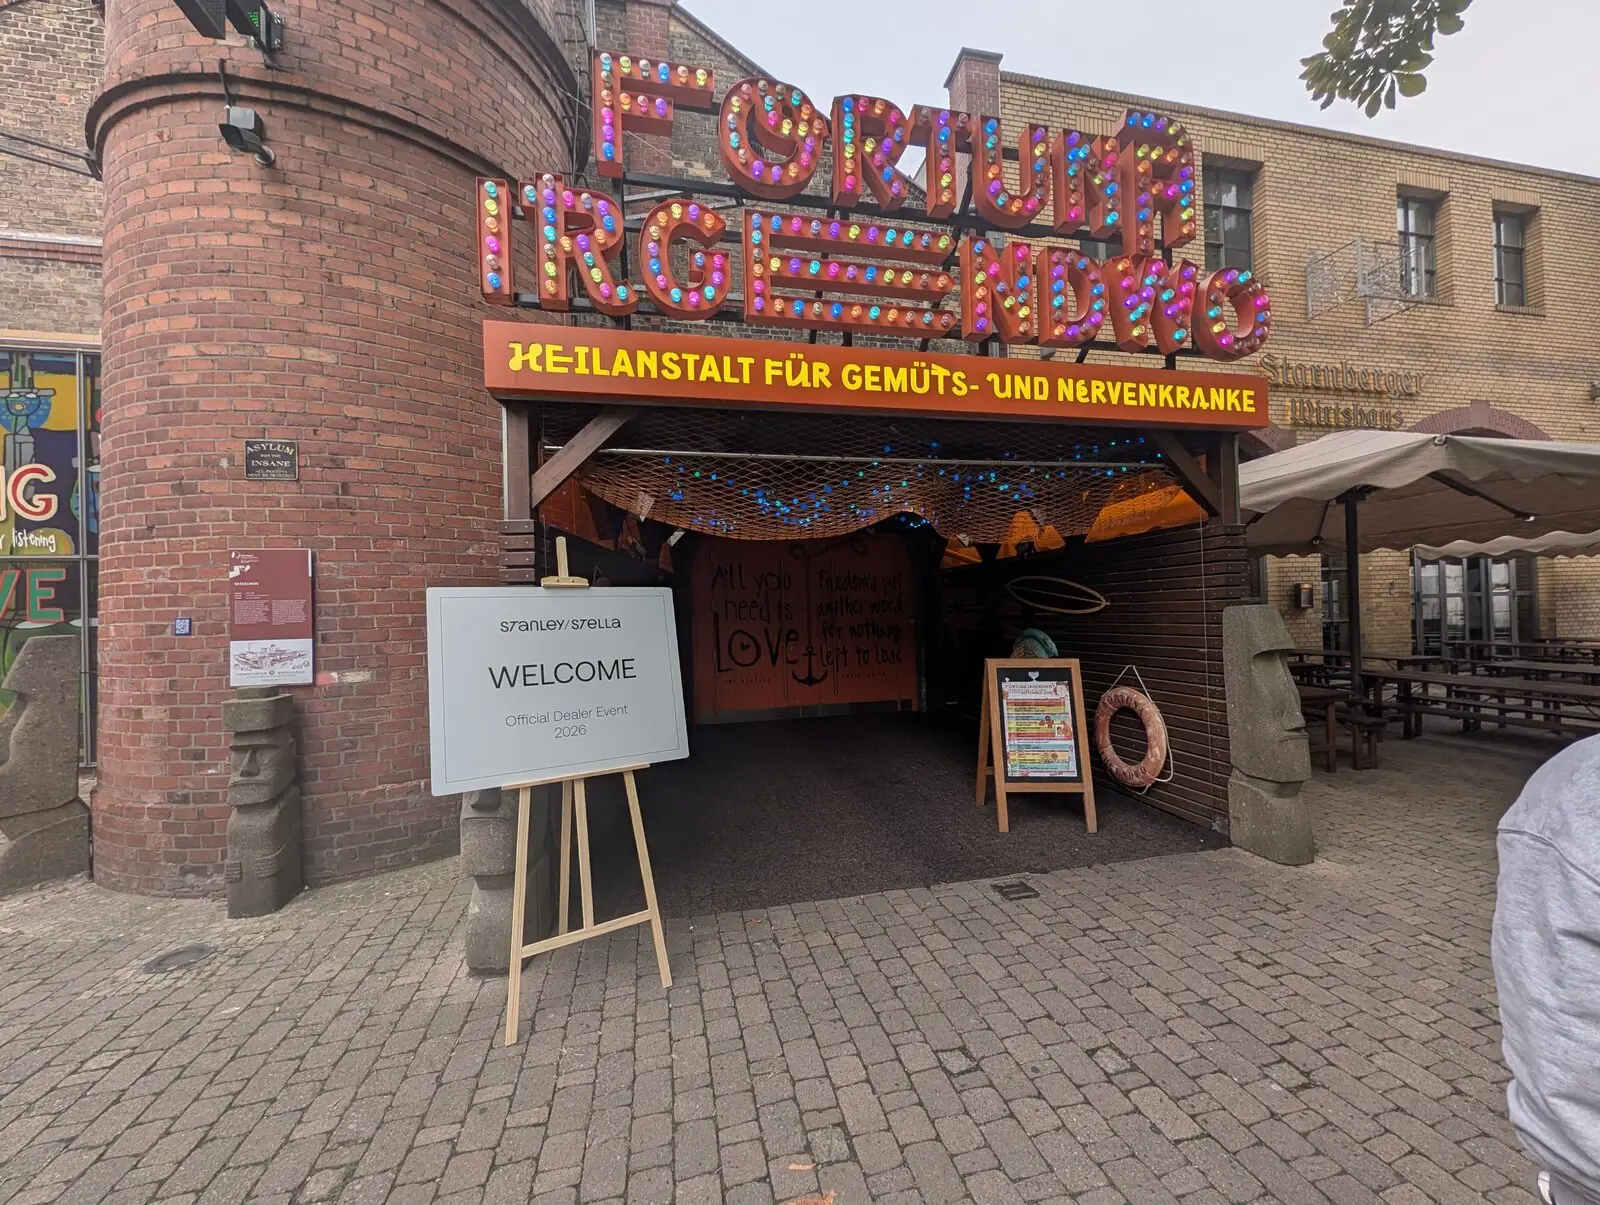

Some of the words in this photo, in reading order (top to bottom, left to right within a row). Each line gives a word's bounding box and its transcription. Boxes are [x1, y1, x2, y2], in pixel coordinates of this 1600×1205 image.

[592, 50, 1196, 256] FORTUNA
[476, 172, 1271, 361] IRGENDWO
[508, 341, 755, 385] HEILANSTALT
[765, 353, 832, 389] FÜR
[841, 361, 979, 397] GEMÜTS-
[988, 373, 1049, 401] UND
[1260, 353, 1425, 398] Starnberger
[1289, 398, 1404, 428] Wirtshaus
[247, 443, 294, 455] ASYLUM
[12, 528, 57, 553] listening
[711, 562, 747, 590] All
[724, 591, 771, 624] need
[855, 647, 869, 666] to
[488, 658, 637, 689] WELCOME
[505, 711, 550, 727] Official
[553, 708, 593, 722] Dealer
[596, 704, 628, 717] Event
[554, 724, 587, 739] 2026
